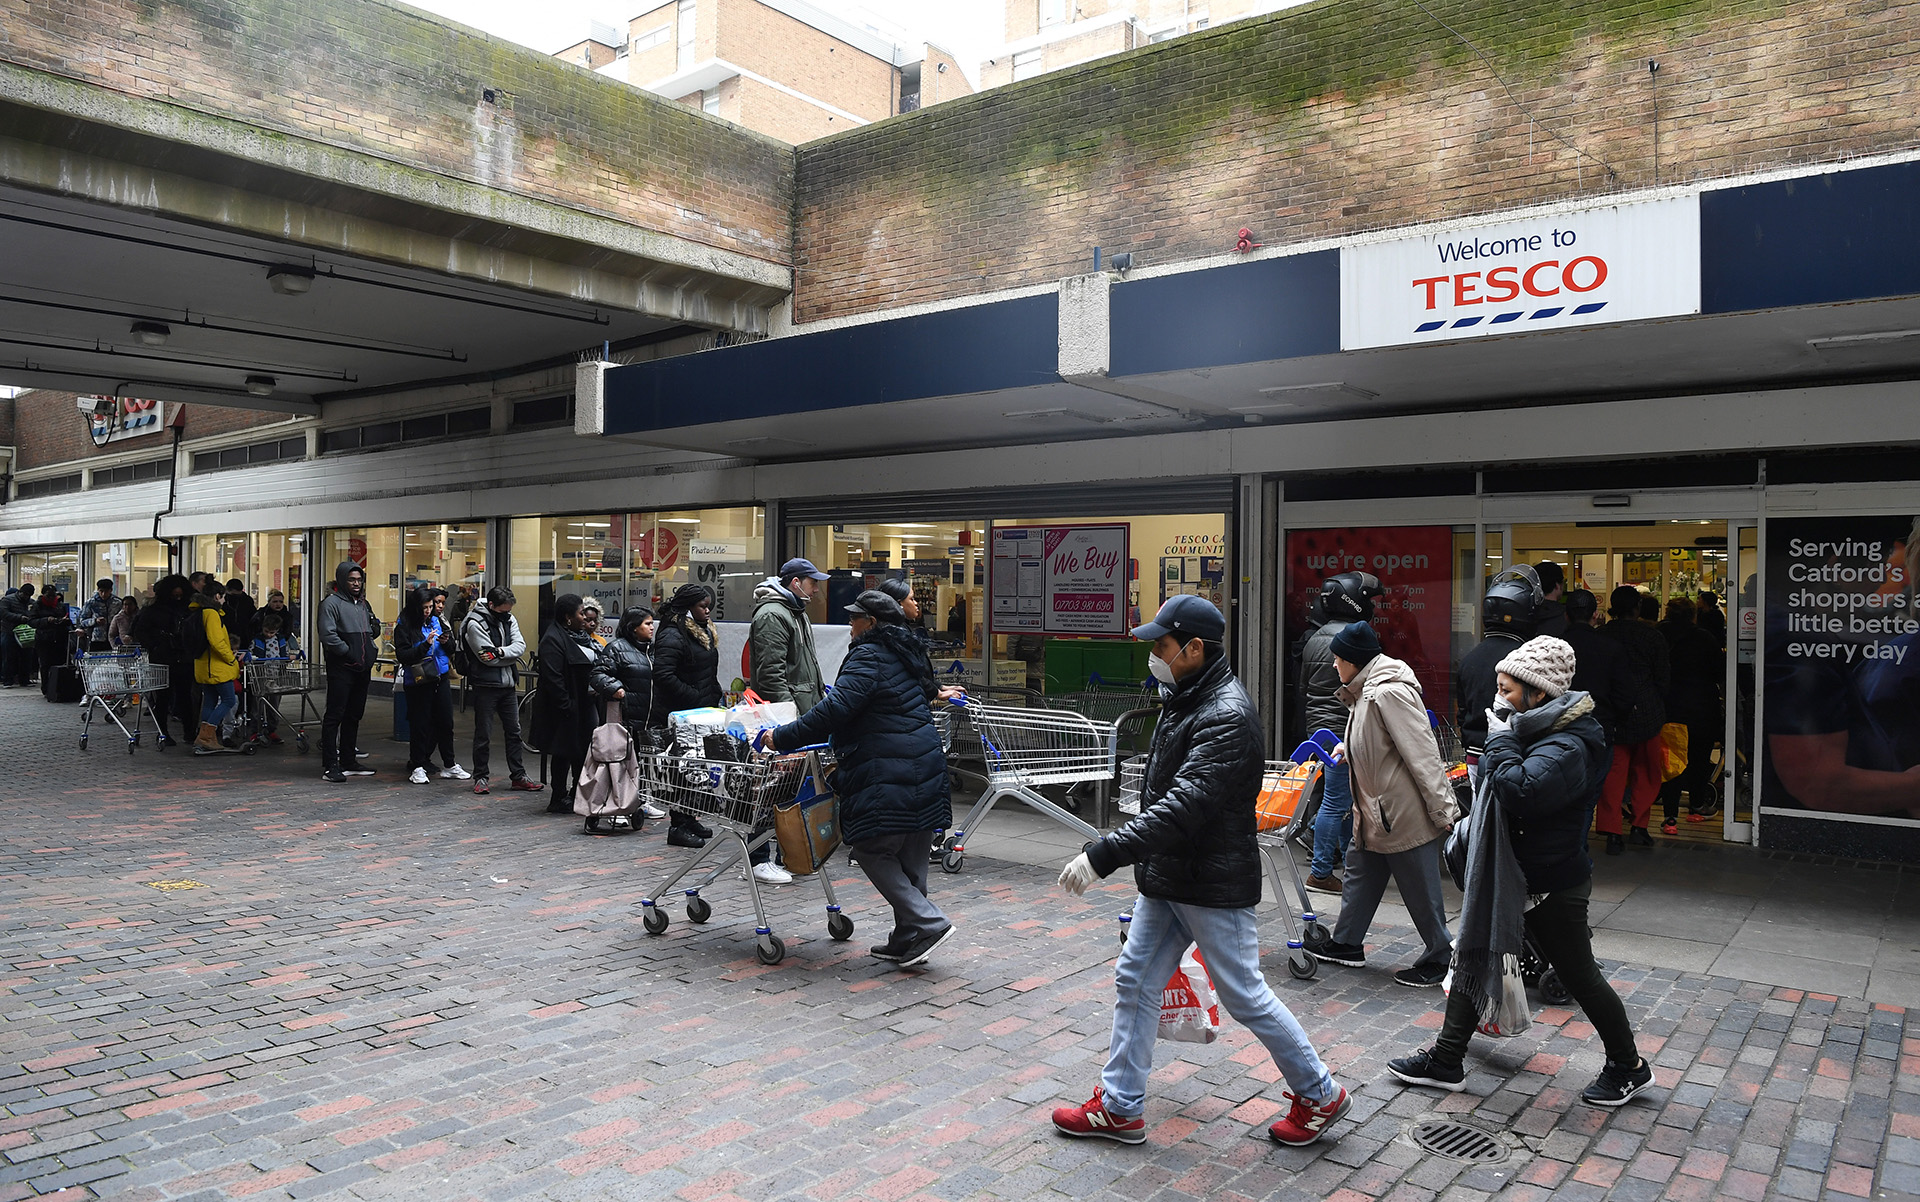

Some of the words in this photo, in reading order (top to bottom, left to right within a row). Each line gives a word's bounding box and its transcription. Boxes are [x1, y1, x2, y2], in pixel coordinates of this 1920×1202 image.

[1437, 234, 1542, 263] Welcome
[1551, 228, 1577, 248] to
[1412, 255, 1608, 310] TESCO
[1175, 534, 1208, 544] TESCO
[1212, 534, 1224, 544] CA
[1164, 546, 1224, 554] COMMUNIT
[1788, 537, 1883, 562] Serving
[1054, 550, 1080, 576] We
[1084, 546, 1119, 579] Buy
[1306, 549, 1366, 570] we're
[1372, 554, 1428, 575] open
[1788, 563, 1904, 582] Catford's
[593, 589, 616, 599] Carpet
[1402, 585, 1424, 596] 7pm
[1788, 588, 1907, 612] shoppers
[1055, 600, 1079, 610] 07703
[1081, 601, 1094, 610] 981
[1096, 601, 1112, 611] 696
[1402, 600, 1425, 611] 8pm
[598, 625, 613, 634] SCO
[1788, 613, 1843, 632] little
[1850, 614, 1920, 634] bette
[1787, 642, 1858, 663] every
[1862, 640, 1908, 665] day
